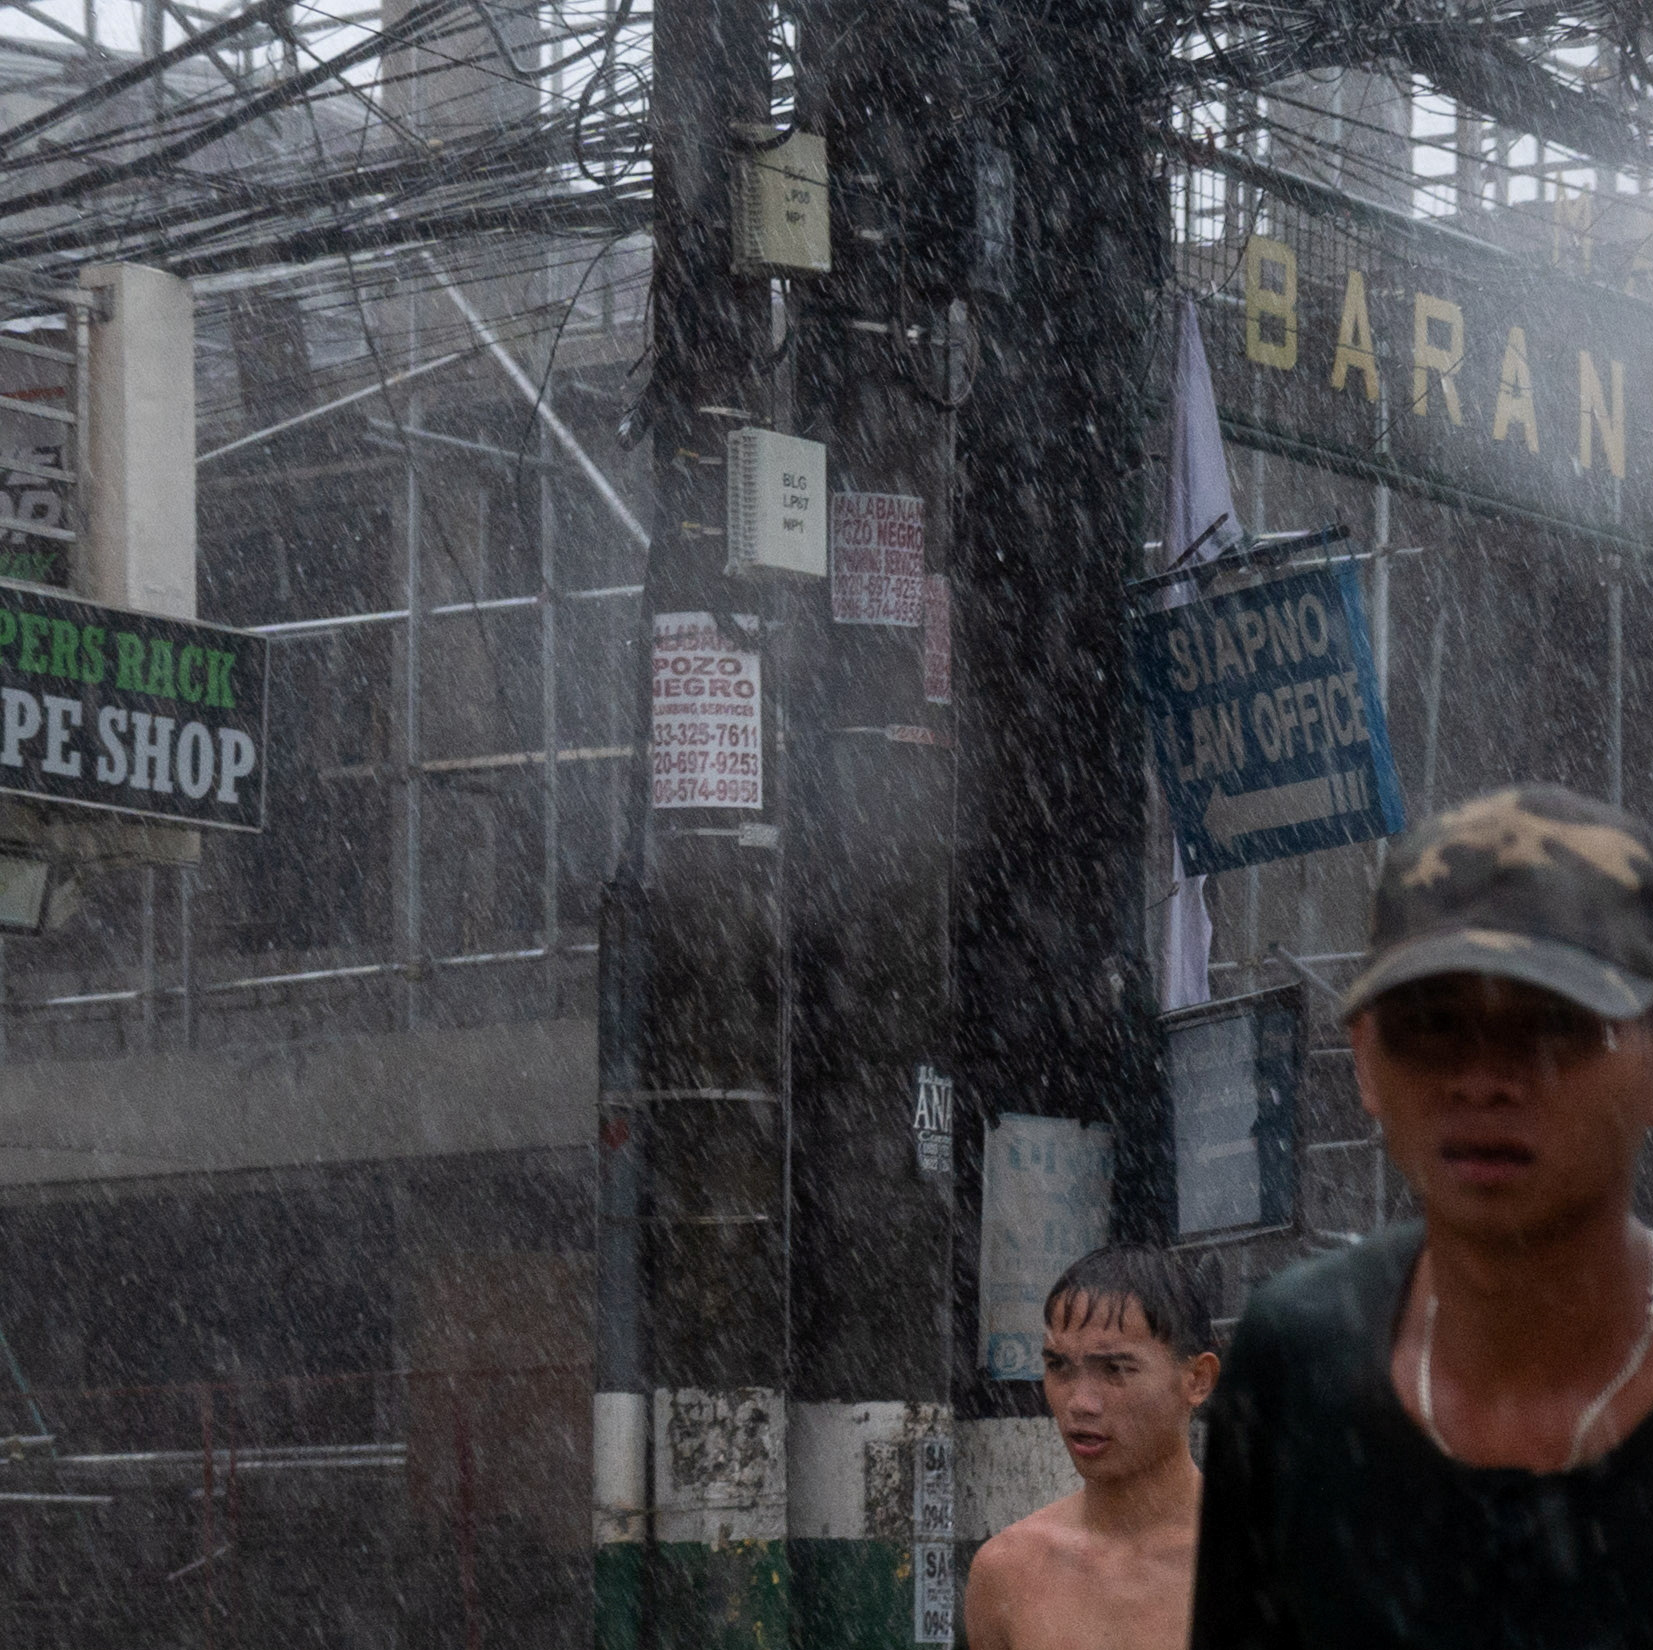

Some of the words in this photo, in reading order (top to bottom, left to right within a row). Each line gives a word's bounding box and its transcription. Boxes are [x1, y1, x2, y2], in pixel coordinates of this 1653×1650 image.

[877, 522, 923, 550] NEGRO
[115, 632, 236, 709] RACK
[653, 656, 742, 677] POZO
[1168, 593, 1329, 692] SIAPNO
[97, 705, 256, 804] SHOP
[1163, 698, 1245, 783] LAW
[1254, 663, 1371, 763] OFFICE
